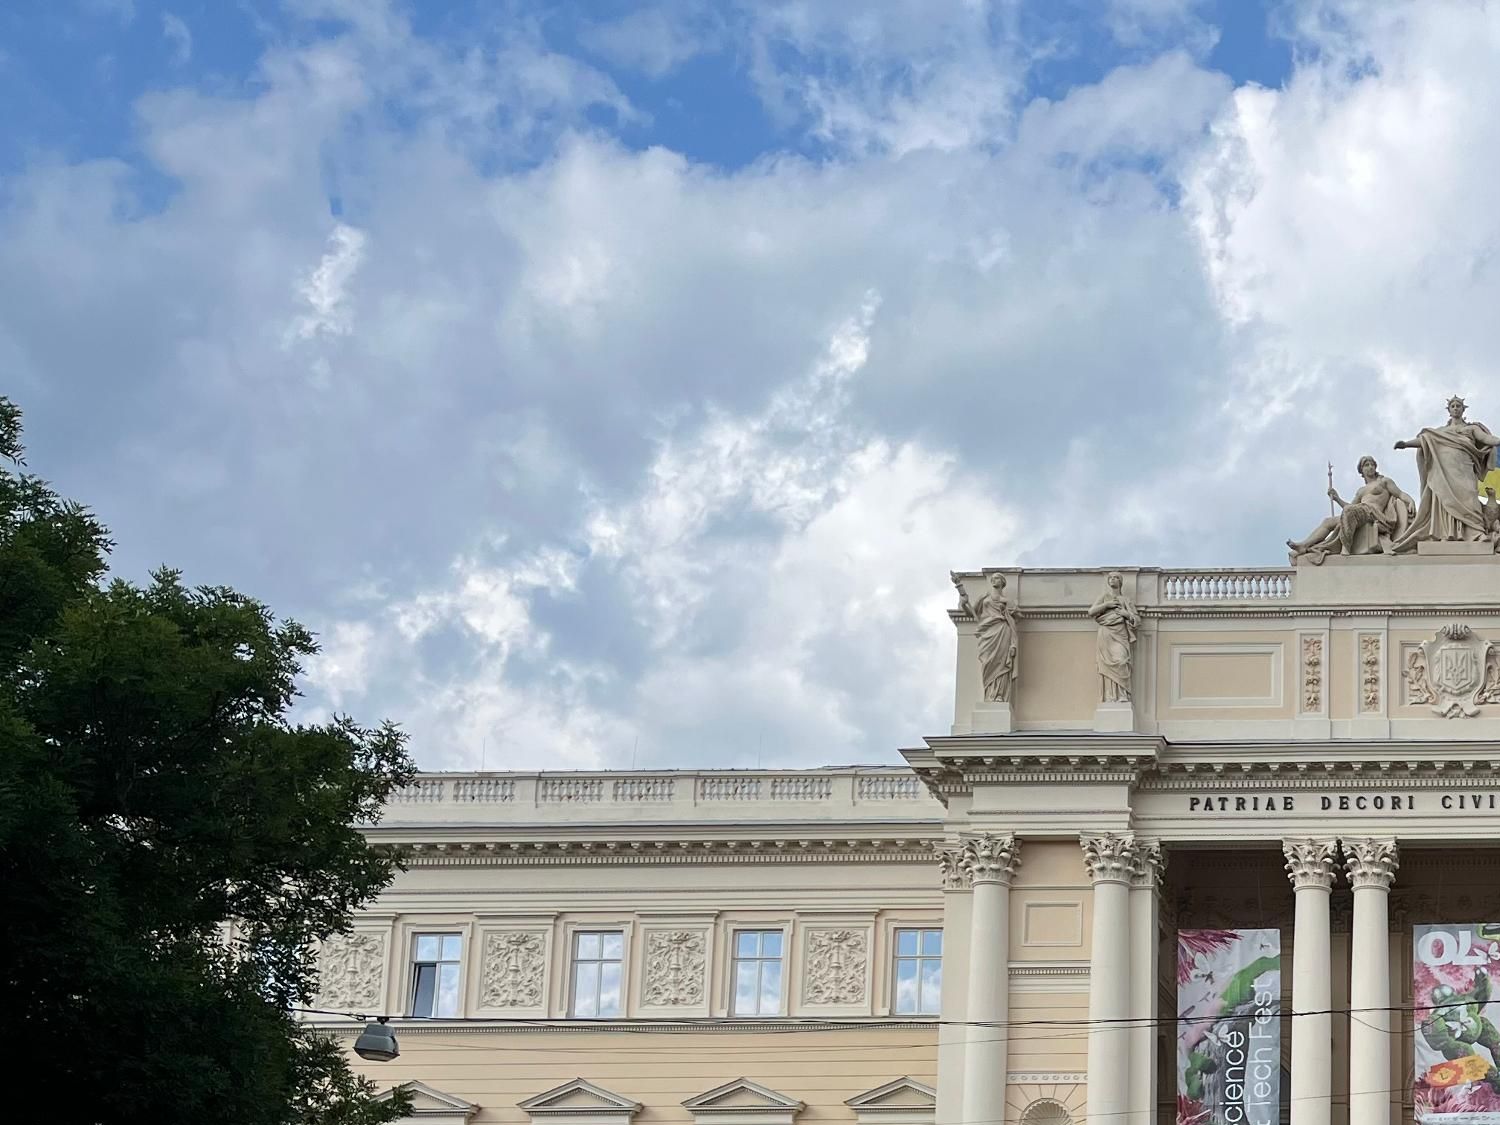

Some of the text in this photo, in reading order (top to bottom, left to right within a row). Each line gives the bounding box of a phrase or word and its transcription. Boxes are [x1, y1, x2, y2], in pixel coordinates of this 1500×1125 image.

[1189, 796, 1294, 811] PATRIAE
[1321, 795, 1414, 810] DECORI
[1249, 979, 1272, 1038] Fest
[1247, 1048, 1272, 1112] Tech
